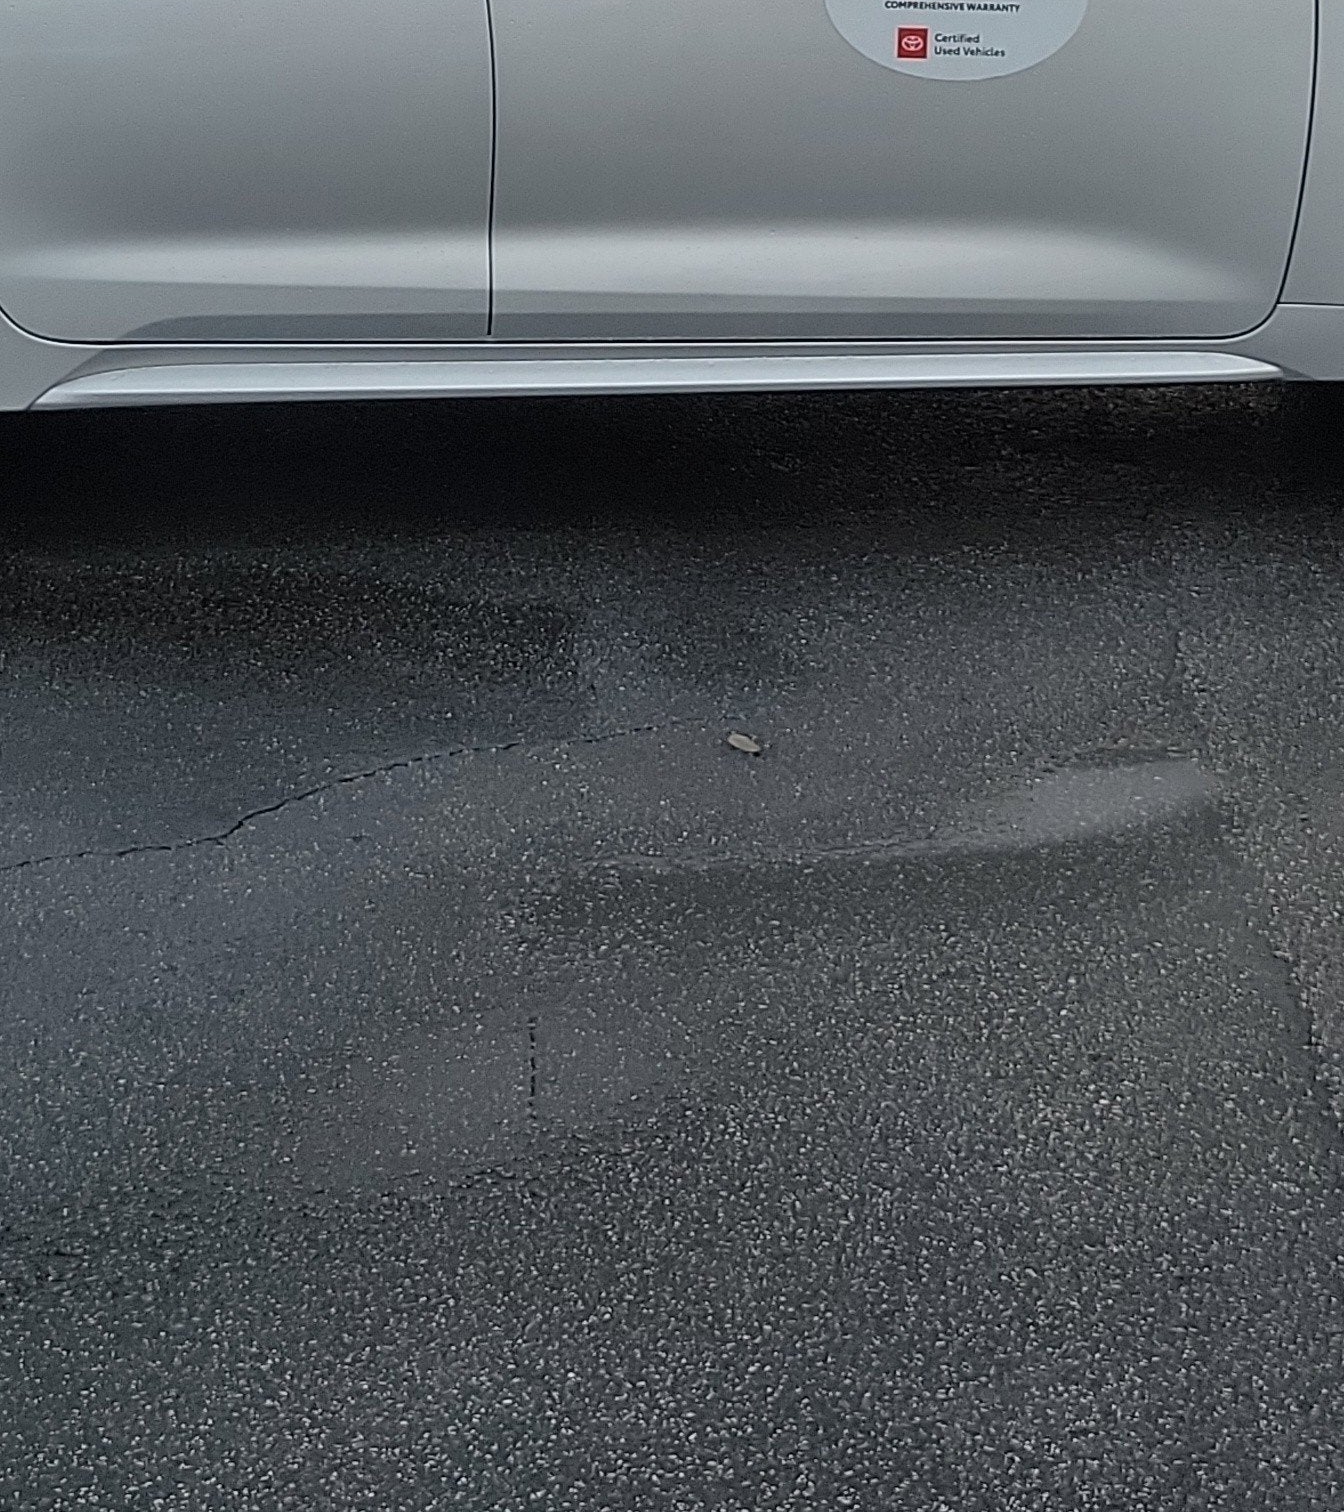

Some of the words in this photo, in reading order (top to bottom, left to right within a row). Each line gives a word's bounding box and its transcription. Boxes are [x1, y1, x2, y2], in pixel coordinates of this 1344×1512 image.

[885, 0, 964, 11] COMPREHENSIVE
[966, 2, 1020, 13] WARRANTY
[934, 33, 980, 43] Certified
[934, 46, 960, 56] Used
[962, 47, 1006, 58] Vehicles
